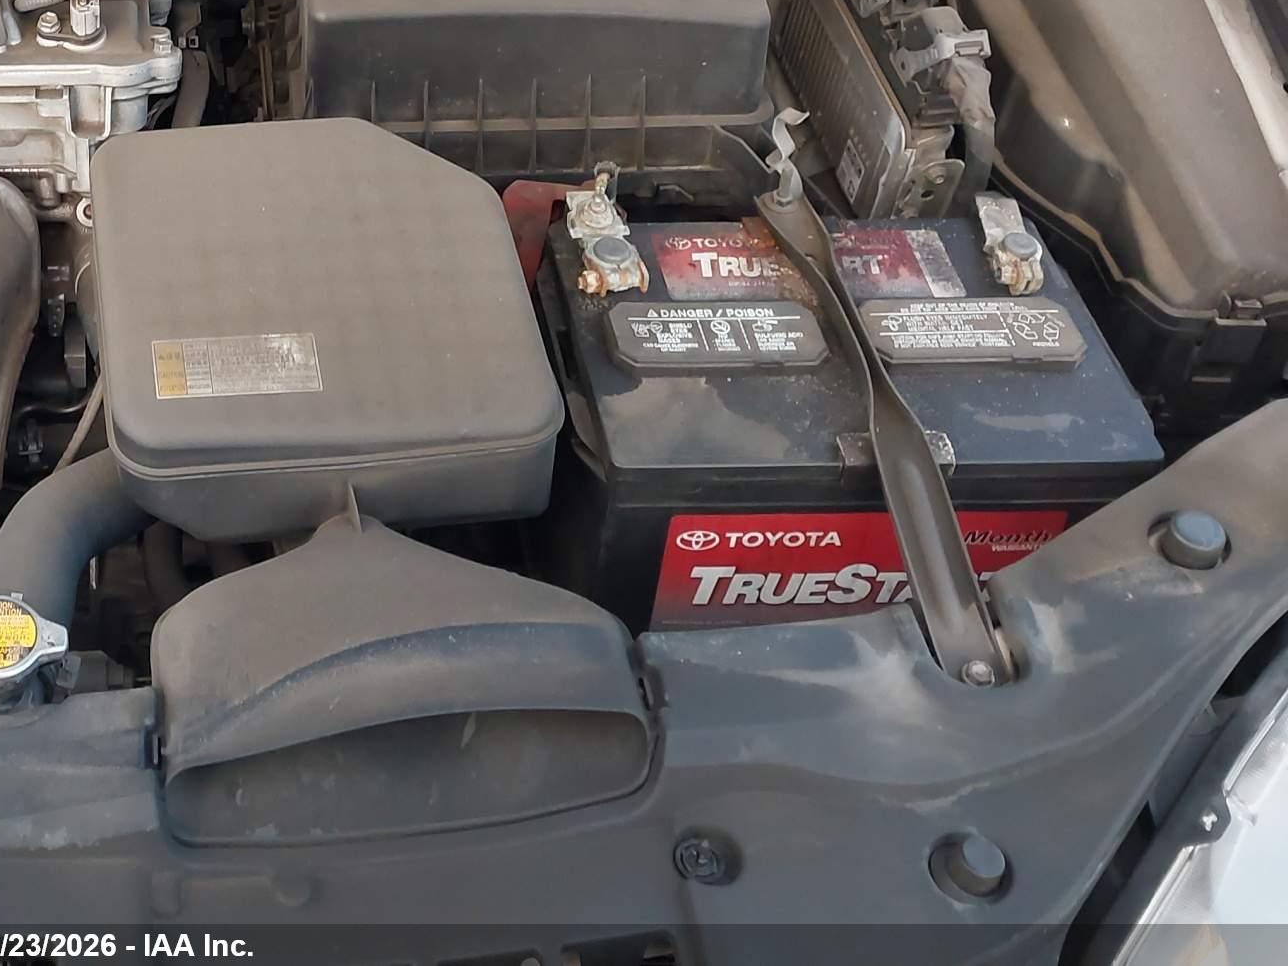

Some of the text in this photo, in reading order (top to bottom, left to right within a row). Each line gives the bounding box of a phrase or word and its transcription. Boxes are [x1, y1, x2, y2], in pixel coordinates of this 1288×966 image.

[660, 309, 713, 318] DANGER
[726, 308, 775, 317] POISON
[725, 531, 842, 548] TOYOTA
